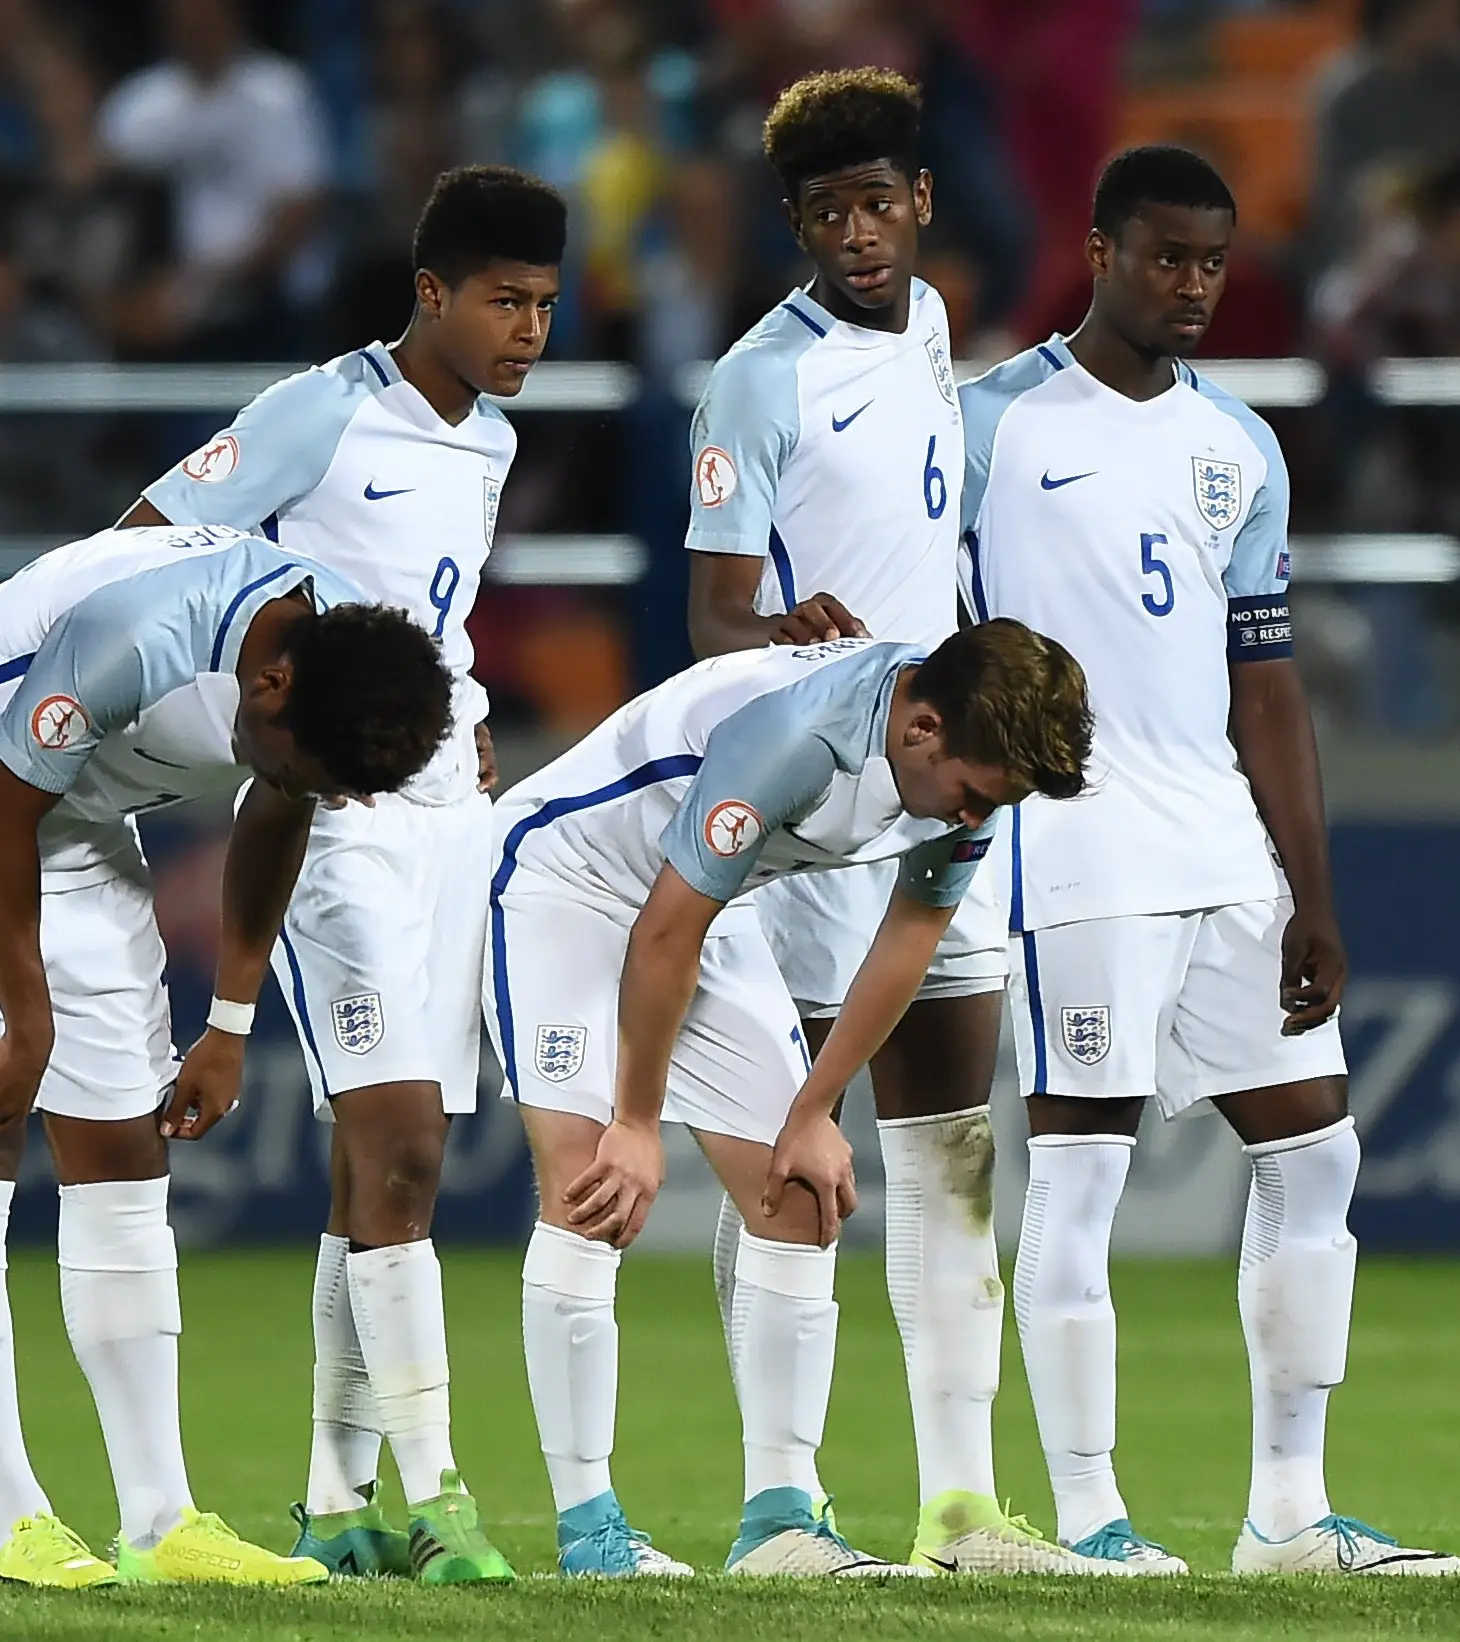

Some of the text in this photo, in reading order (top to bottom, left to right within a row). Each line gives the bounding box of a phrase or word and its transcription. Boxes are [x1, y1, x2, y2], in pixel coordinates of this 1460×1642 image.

[923, 434, 947, 519] 6
[429, 556, 461, 637] 9
[1139, 532, 1175, 617] 5
[1231, 611, 1252, 623] NO
[1252, 608, 1270, 621] TO
